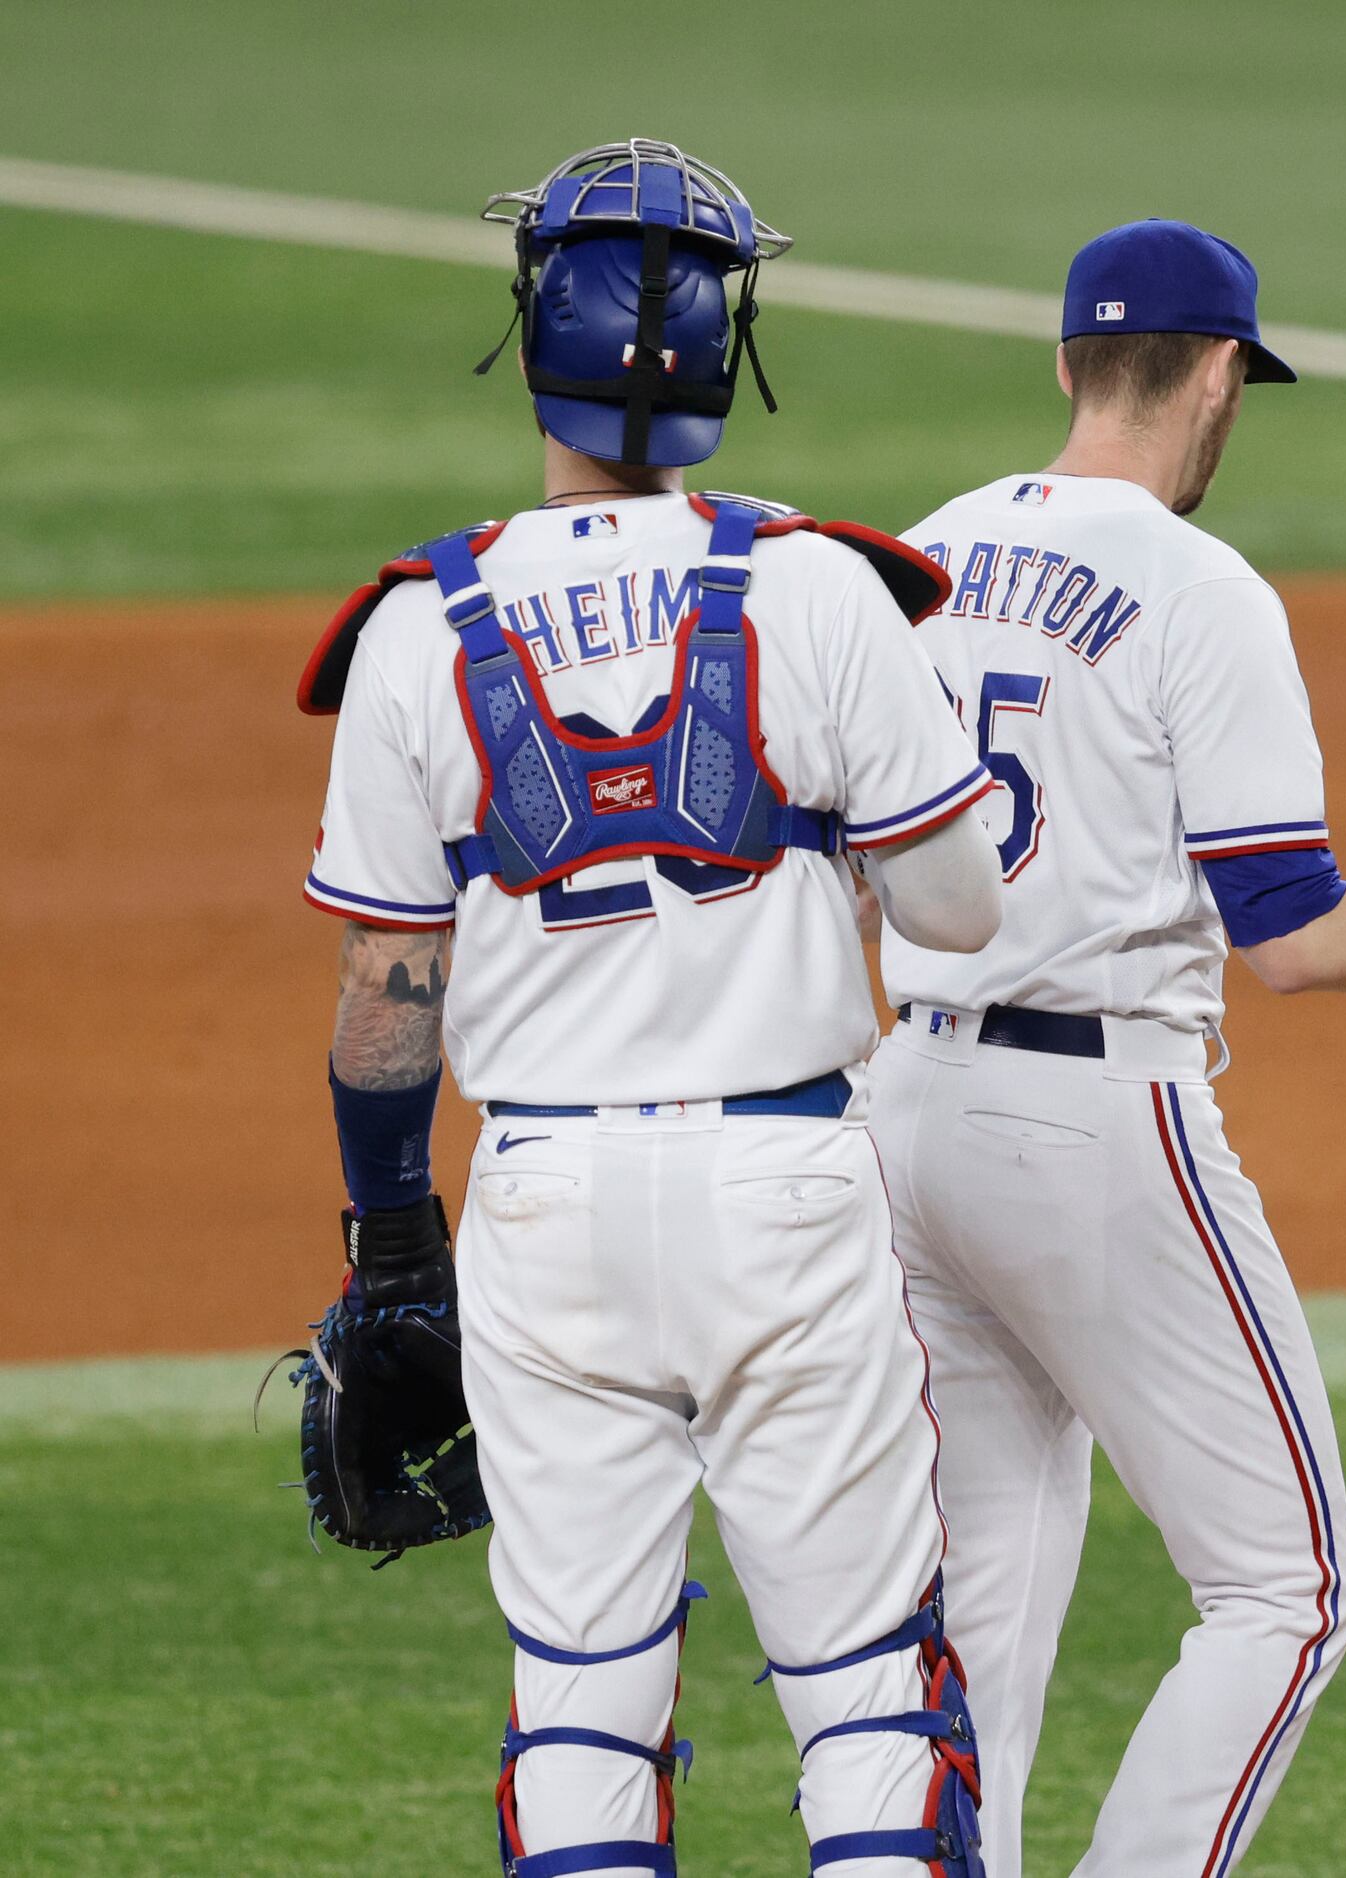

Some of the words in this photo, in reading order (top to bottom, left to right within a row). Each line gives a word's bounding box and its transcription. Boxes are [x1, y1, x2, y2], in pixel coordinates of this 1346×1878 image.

[501, 566, 702, 677] HEIM
[595, 777, 648, 802] Rawlings
[933, 668, 1051, 884] 5
[349, 1220, 361, 1267] ALL-STAR
